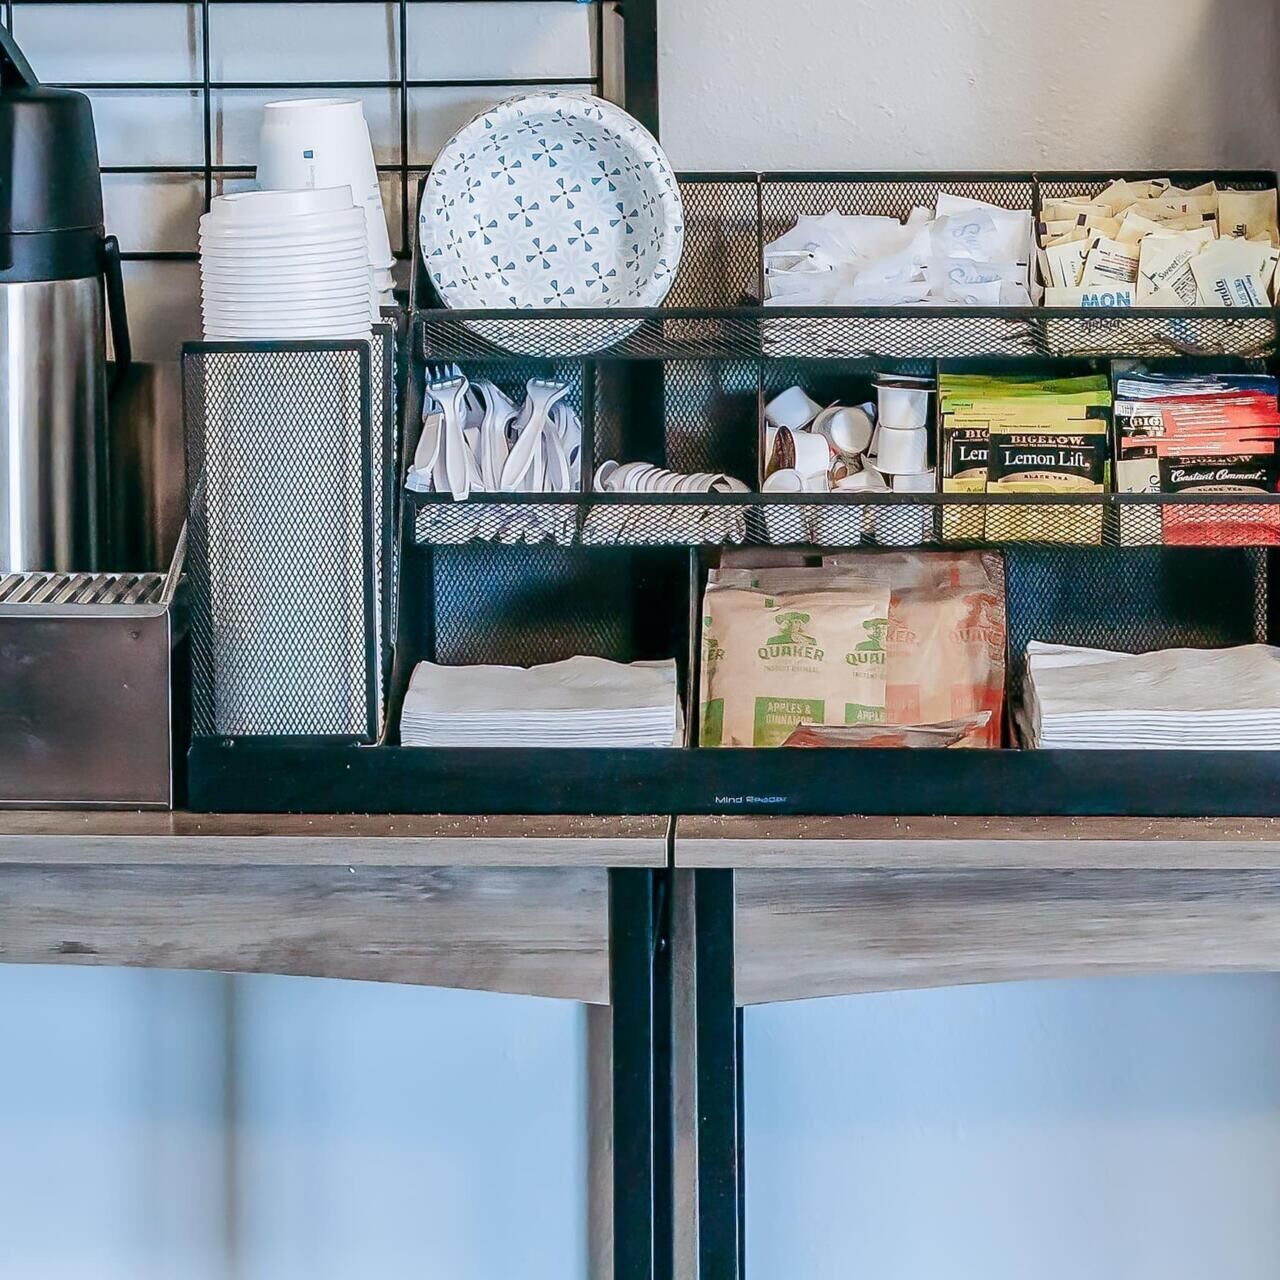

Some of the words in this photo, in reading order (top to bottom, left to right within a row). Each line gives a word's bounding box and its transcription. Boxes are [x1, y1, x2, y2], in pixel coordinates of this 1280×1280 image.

[1010, 435, 1085, 445] BIGELOW
[1005, 451, 1056, 466] Lemon
[757, 646, 825, 662] QUAKER
[767, 702, 802, 714] APPLES
[804, 704, 812, 714] &
[715, 795, 743, 804] Mind
